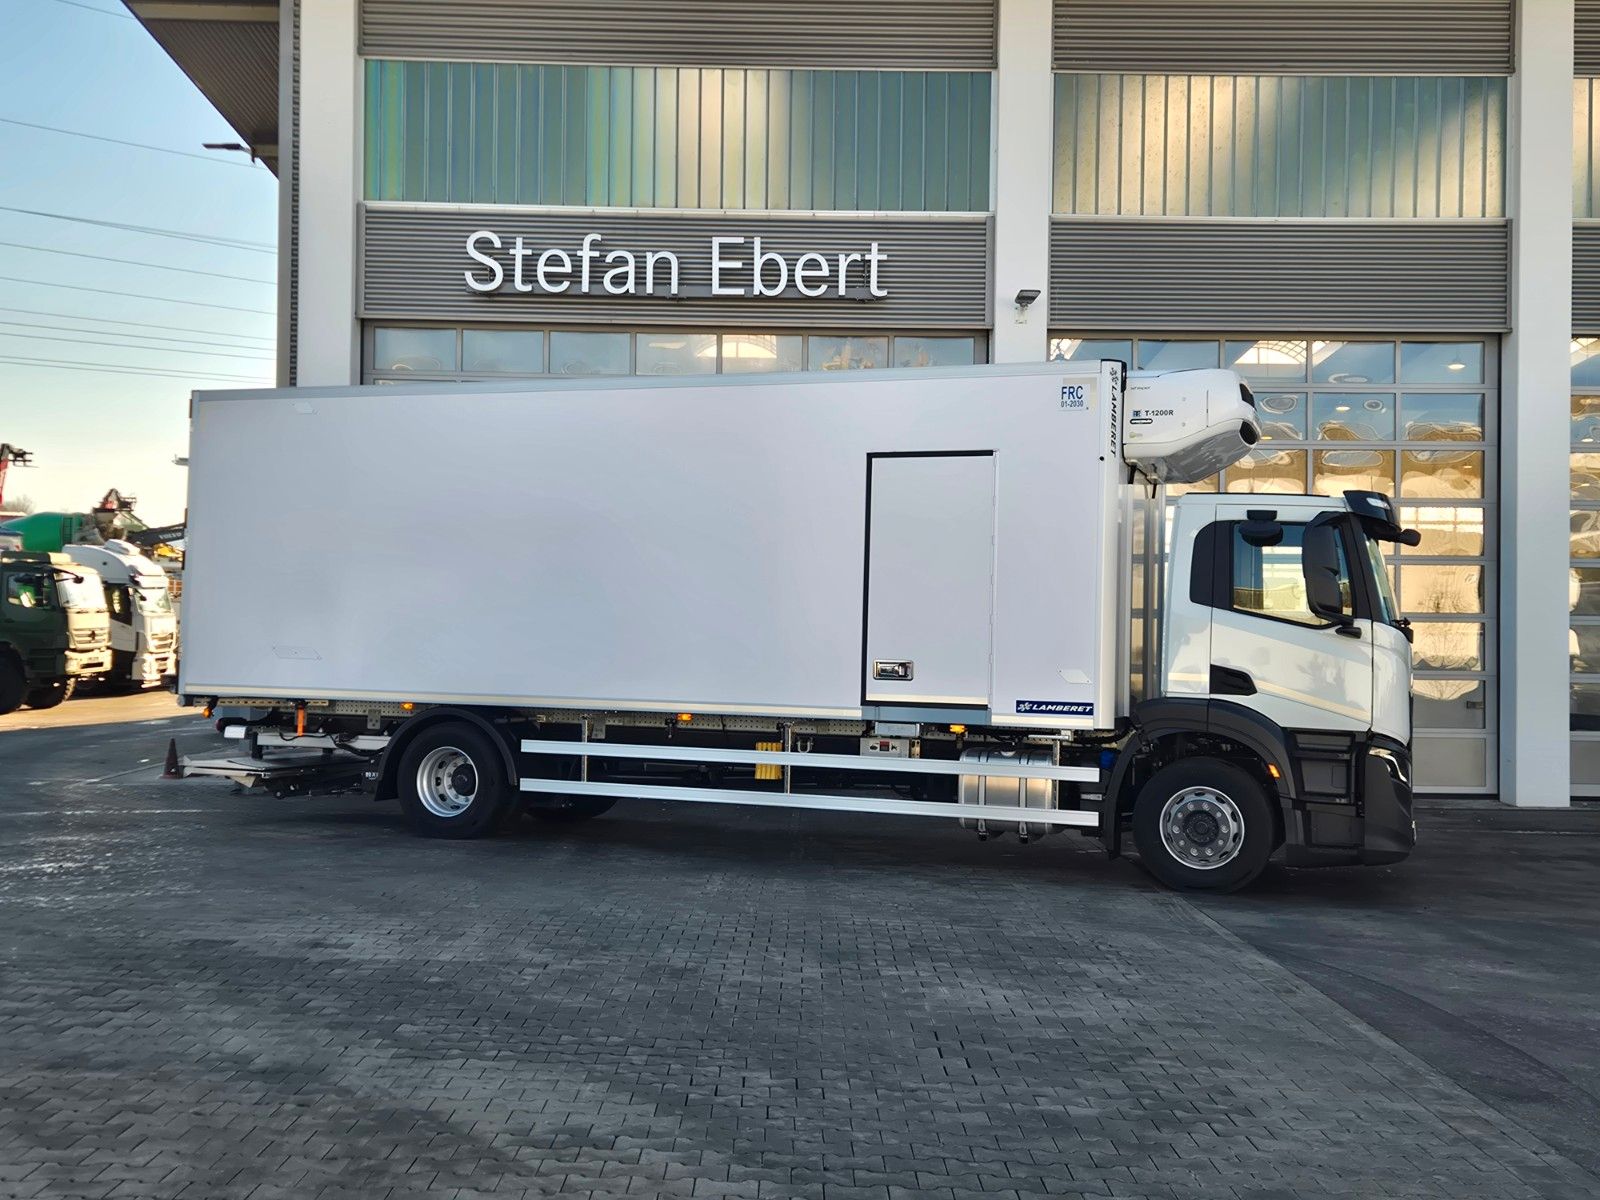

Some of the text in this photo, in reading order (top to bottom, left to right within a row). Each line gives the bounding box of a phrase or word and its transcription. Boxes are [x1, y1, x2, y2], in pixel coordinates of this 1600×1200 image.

[464, 230, 888, 297] Stefan Ebert
[1061, 385, 1084, 400] FRC
[1060, 400, 1084, 408] 01-2030
[1110, 385, 1118, 458] LAMBERET
[1032, 704, 1093, 712] LAMBERET
